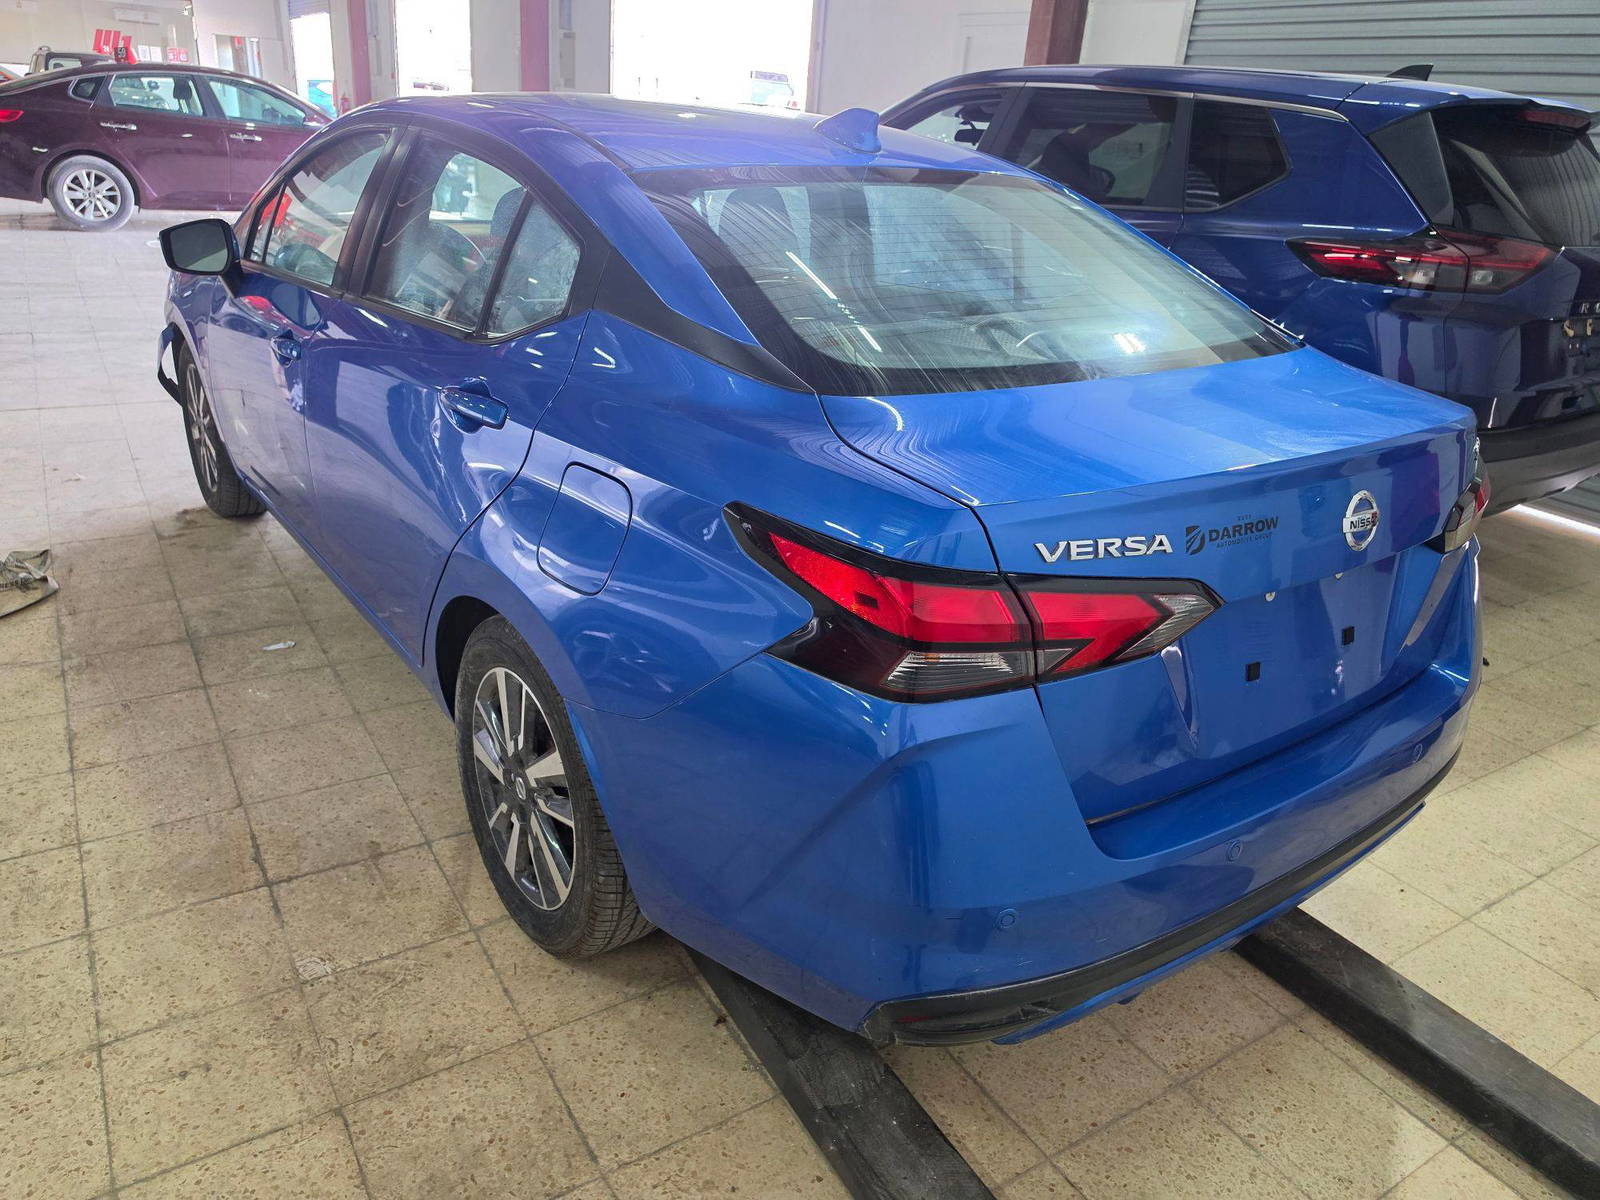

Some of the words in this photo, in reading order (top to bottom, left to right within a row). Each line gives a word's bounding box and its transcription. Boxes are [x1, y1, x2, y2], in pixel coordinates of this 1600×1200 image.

[1208, 516, 1279, 542] DARROW
[1350, 513, 1376, 530] NISS
[1035, 534, 1174, 563] VERSA
